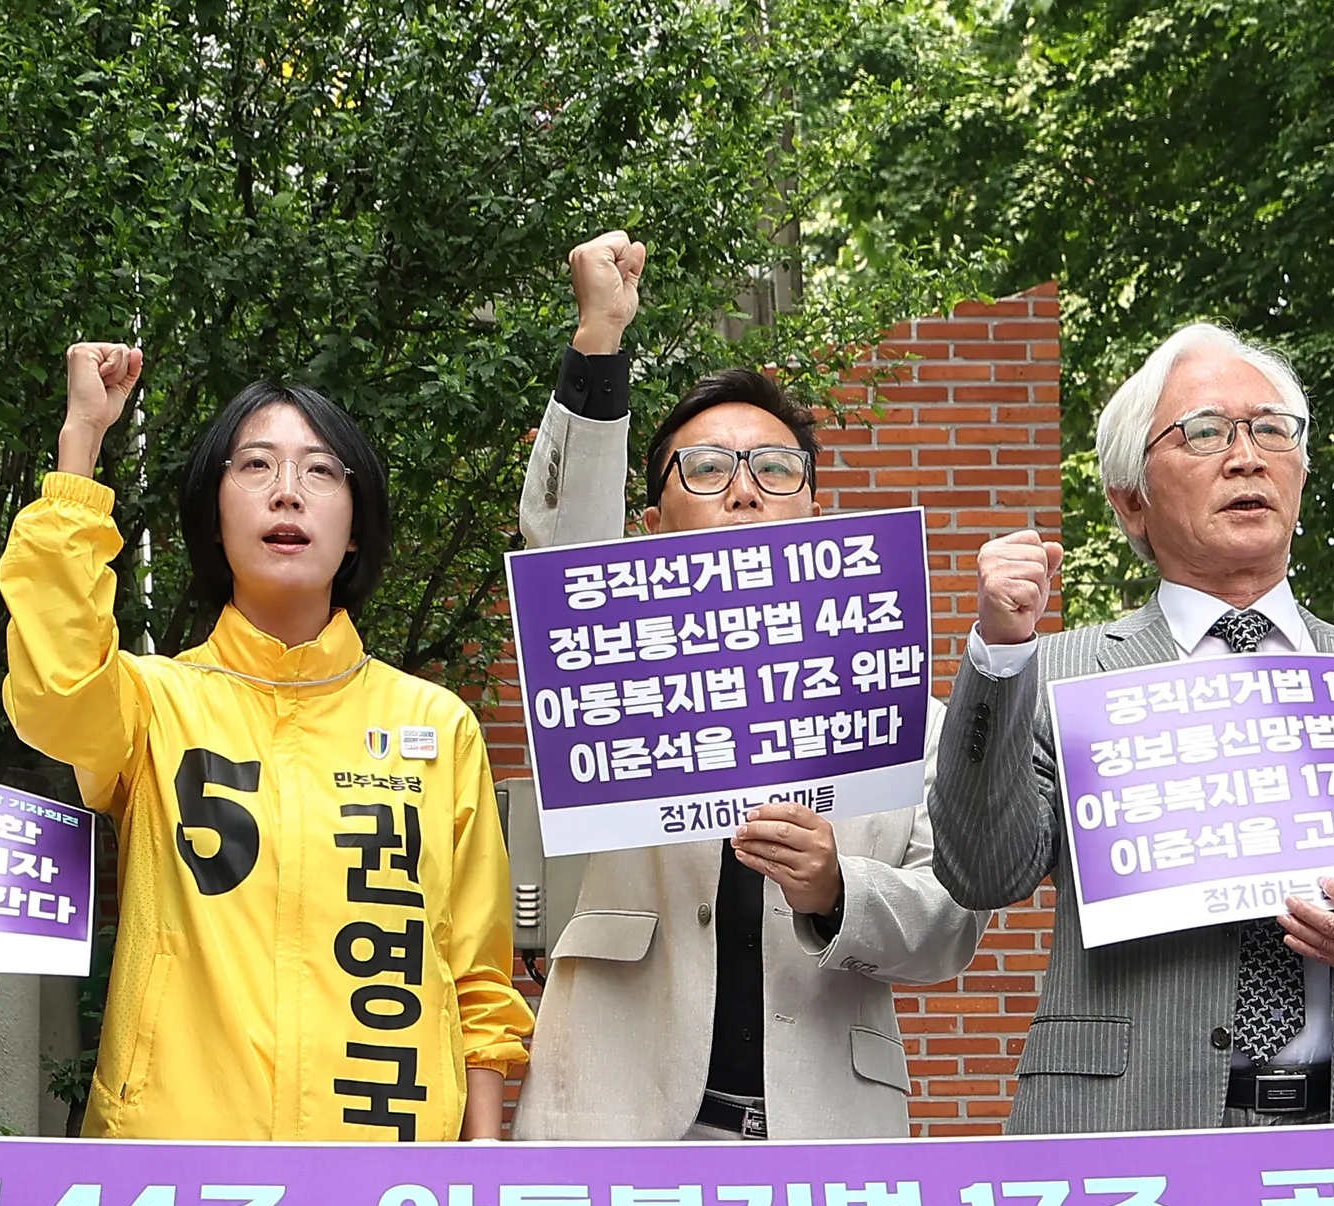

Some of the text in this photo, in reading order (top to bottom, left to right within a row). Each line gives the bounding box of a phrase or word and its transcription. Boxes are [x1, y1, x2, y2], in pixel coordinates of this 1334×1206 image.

[564, 534, 882, 611] 공직선거법 110조
[549, 590, 904, 671] 정보통신망법 44조
[535, 644, 924, 729] 아동복지법 17조 위반
[1105, 669, 1315, 726] 공직선거법
[333, 771, 422, 794] 민주노동당
[569, 705, 903, 783] 이준석을 고발한다
[8, 796, 80, 828] 기자회견
[174, 747, 262, 896] 5
[1076, 765, 1292, 831] 아동복지법
[1110, 816, 1281, 876] 이준석을
[333, 802, 427, 1141] 권영국
